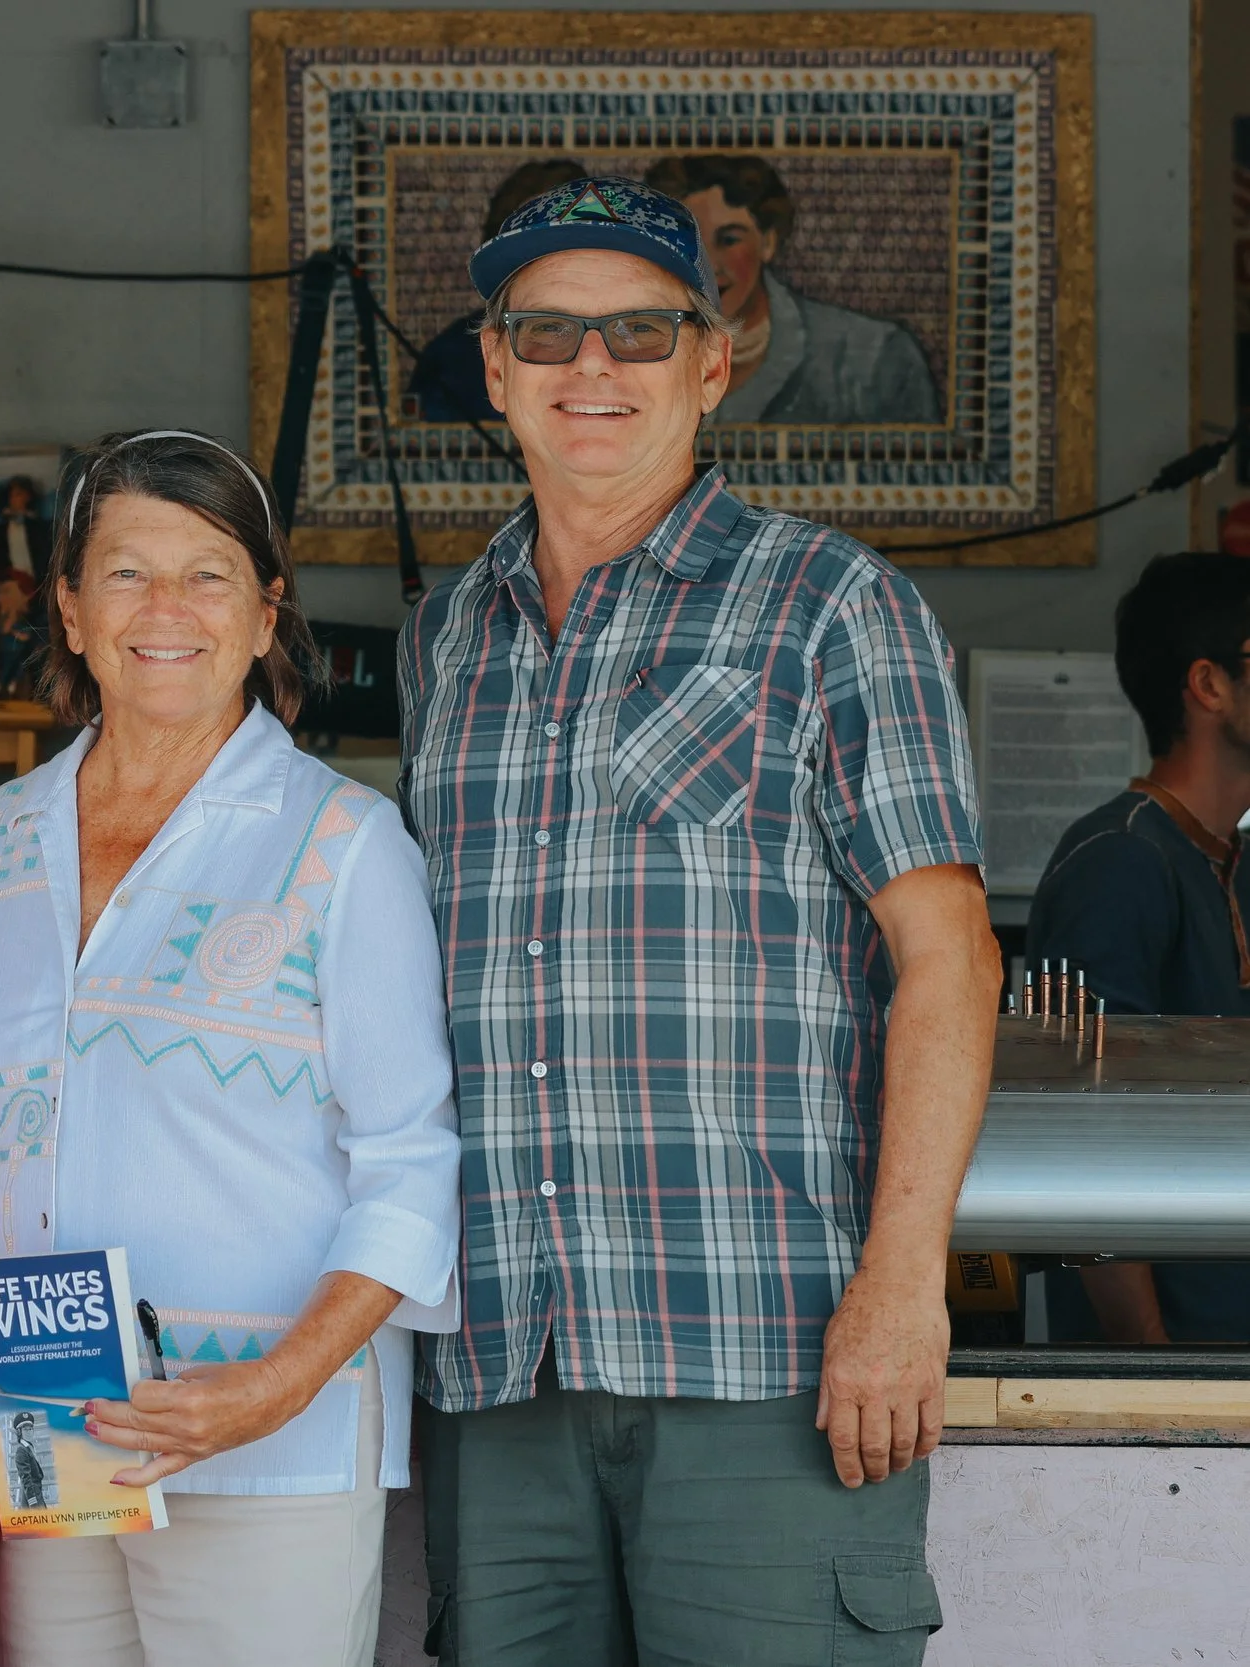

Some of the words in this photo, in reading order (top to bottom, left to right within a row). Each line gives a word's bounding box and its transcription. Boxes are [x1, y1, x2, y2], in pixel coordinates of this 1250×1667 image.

[24, 1270, 104, 1299] TAKES
[10, 1345, 36, 1354] LESSONS
[36, 1343, 62, 1351] LEARNED
[25, 1353, 43, 1361] FIRST
[44, 1351, 69, 1360] FEMALE
[70, 1350, 82, 1358] 747
[82, 1348, 101, 1356] PILOT
[10, 1515, 48, 1526] CAPTAIN
[50, 1513, 75, 1523] LYNN
[77, 1507, 140, 1520] RIPPELMEYER
